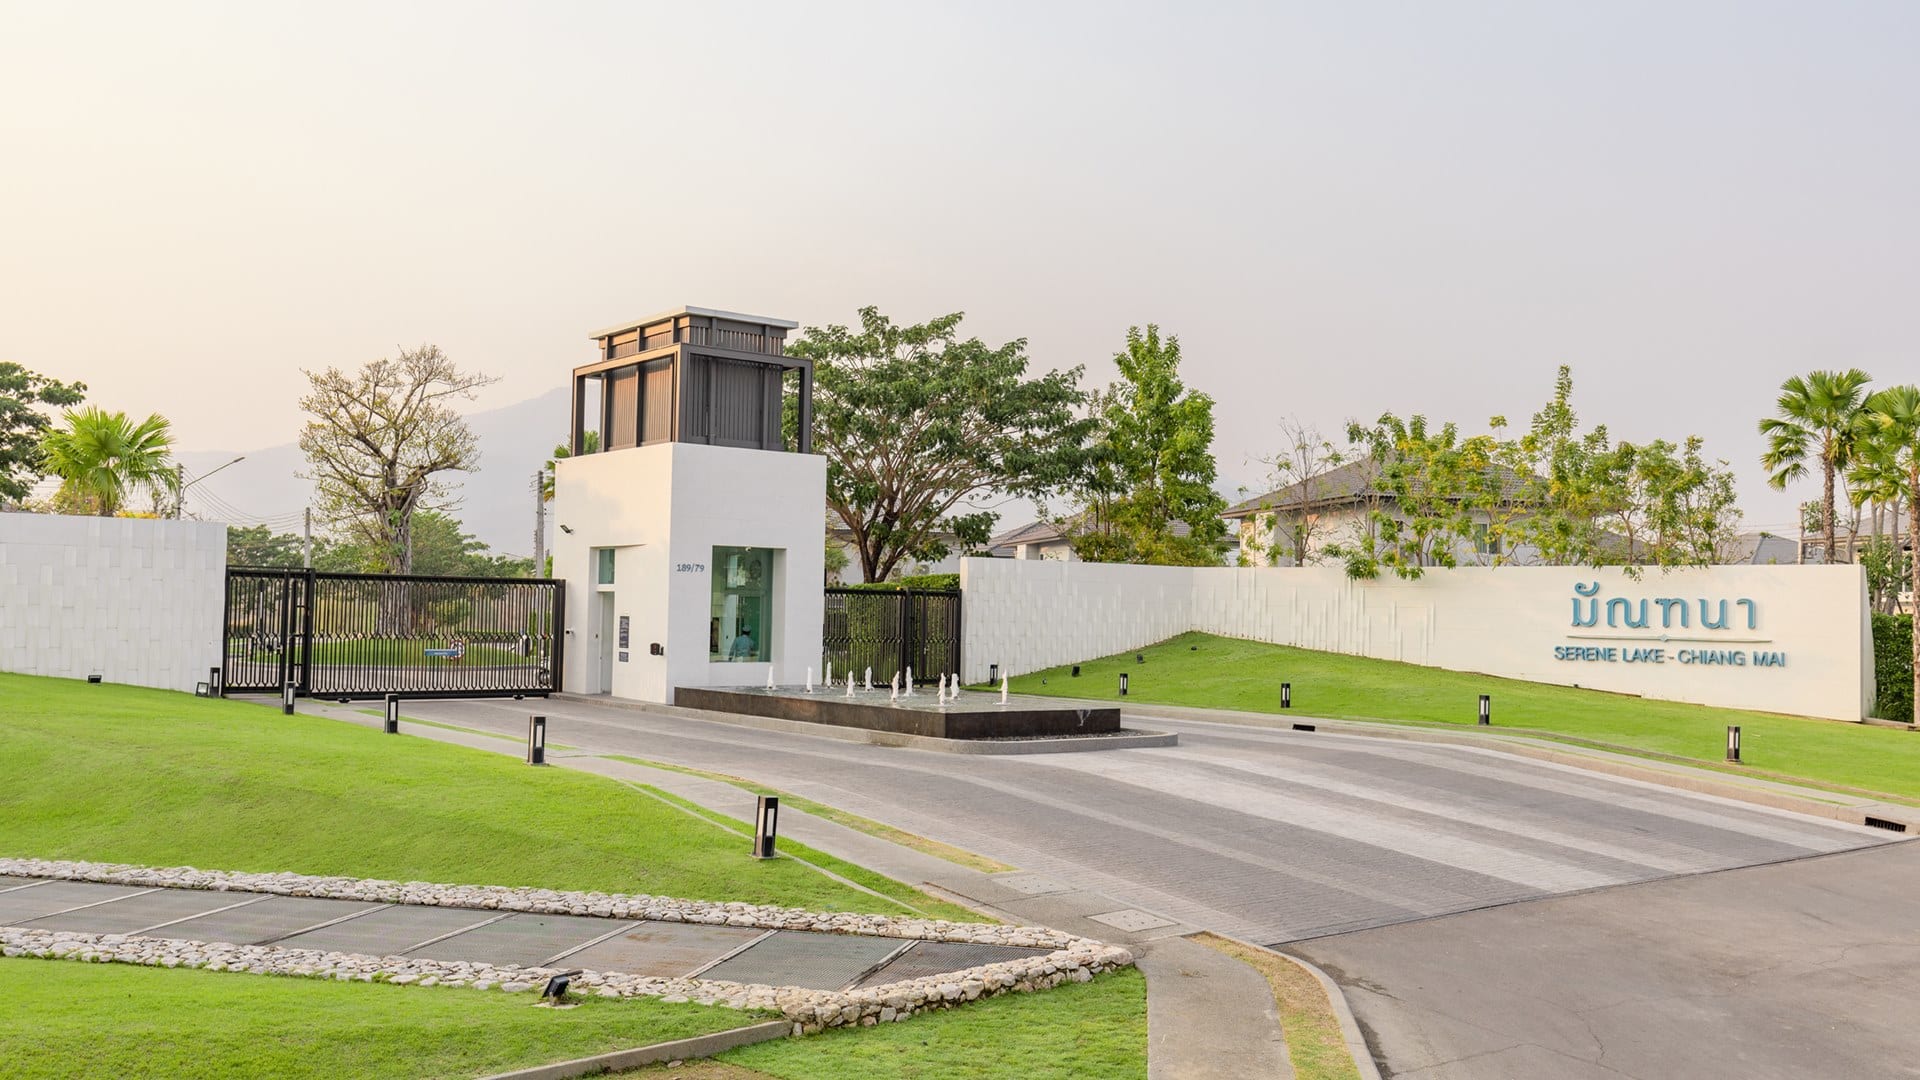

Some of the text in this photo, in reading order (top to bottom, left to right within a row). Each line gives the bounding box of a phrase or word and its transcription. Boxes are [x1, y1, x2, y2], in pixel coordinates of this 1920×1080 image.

[676, 563, 705, 573] 189/79
[1554, 646, 1617, 662] SERENE
[1622, 648, 1665, 664] LAKE
[1677, 649, 1746, 667] CHIANG
[1752, 651, 1786, 668] MAI
